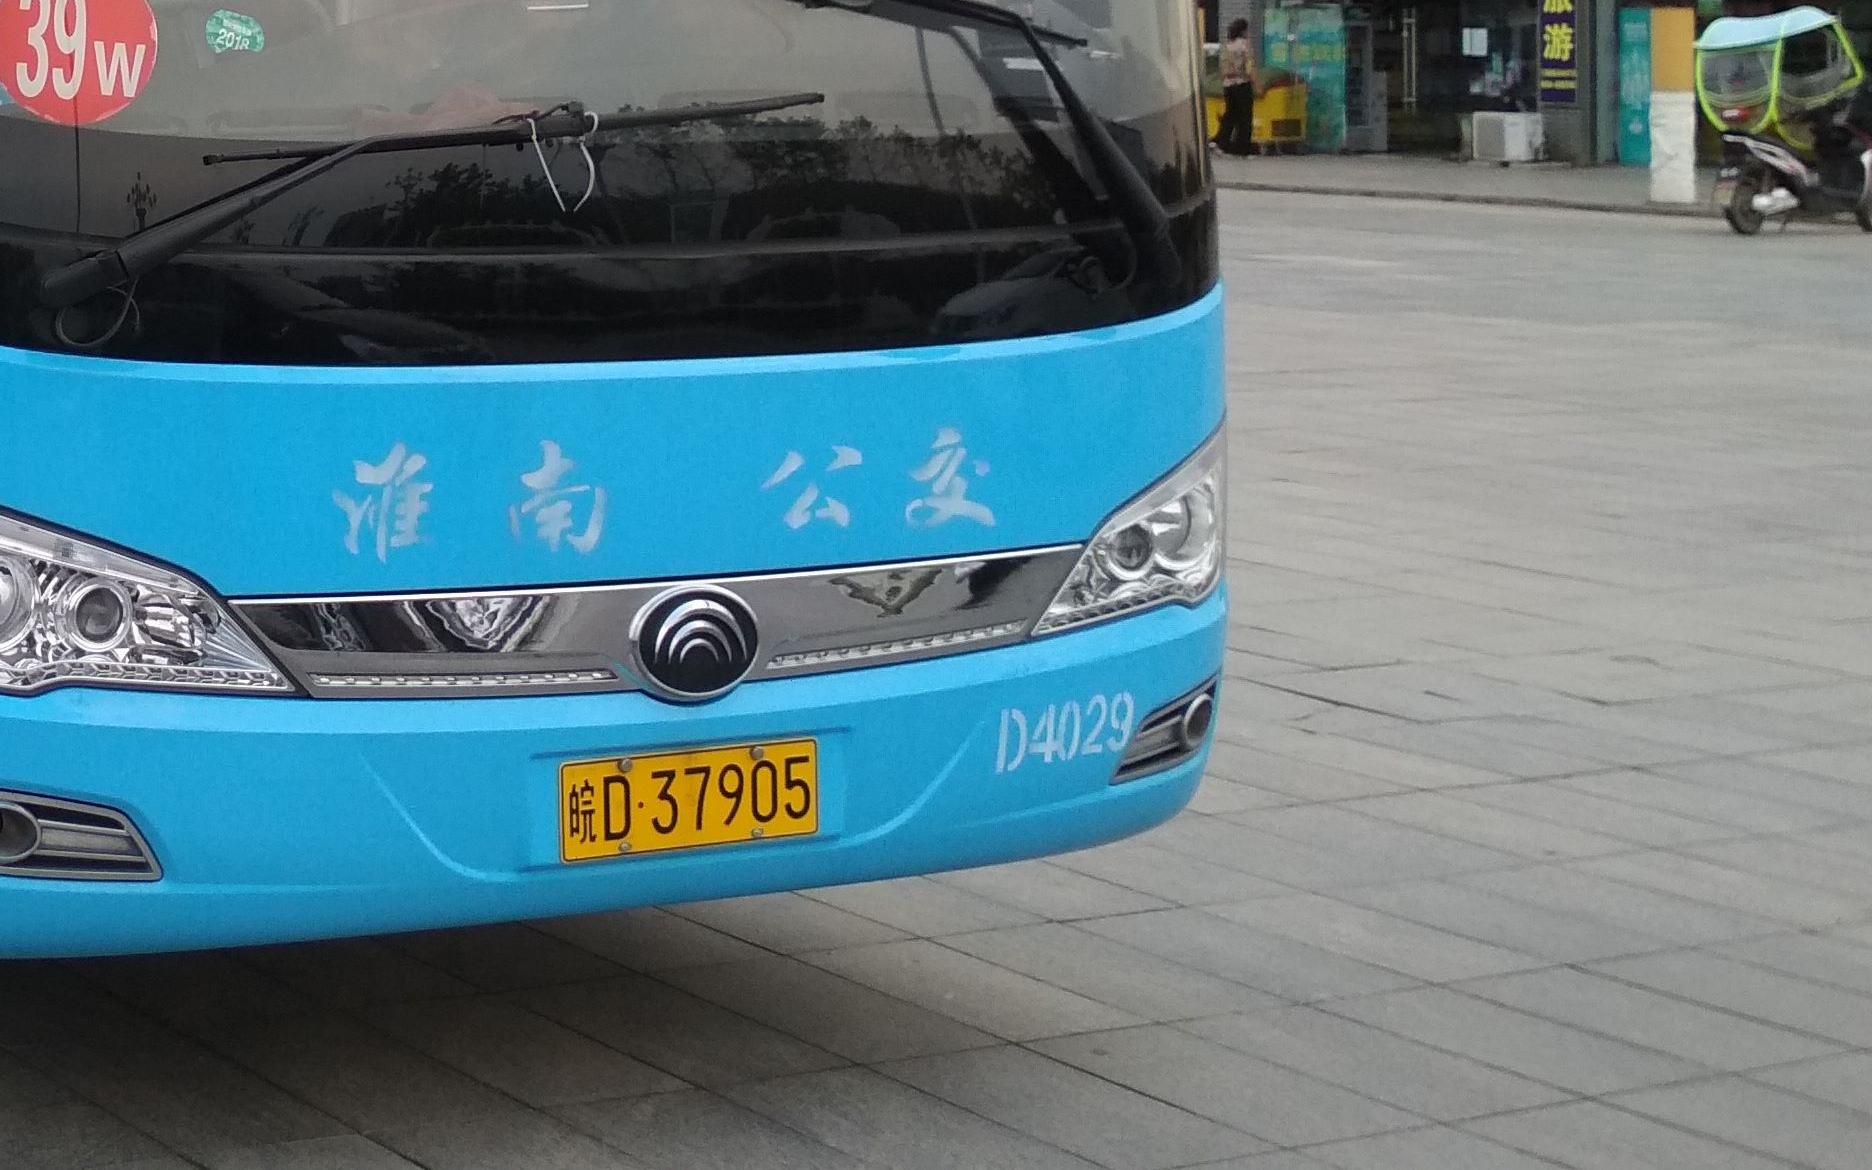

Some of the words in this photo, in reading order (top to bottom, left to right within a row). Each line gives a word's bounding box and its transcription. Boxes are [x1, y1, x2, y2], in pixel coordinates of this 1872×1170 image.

[216, 28, 250, 51] 2018
[332, 428, 996, 563] 淮南公交
[995, 691, 1134, 774] D4029
